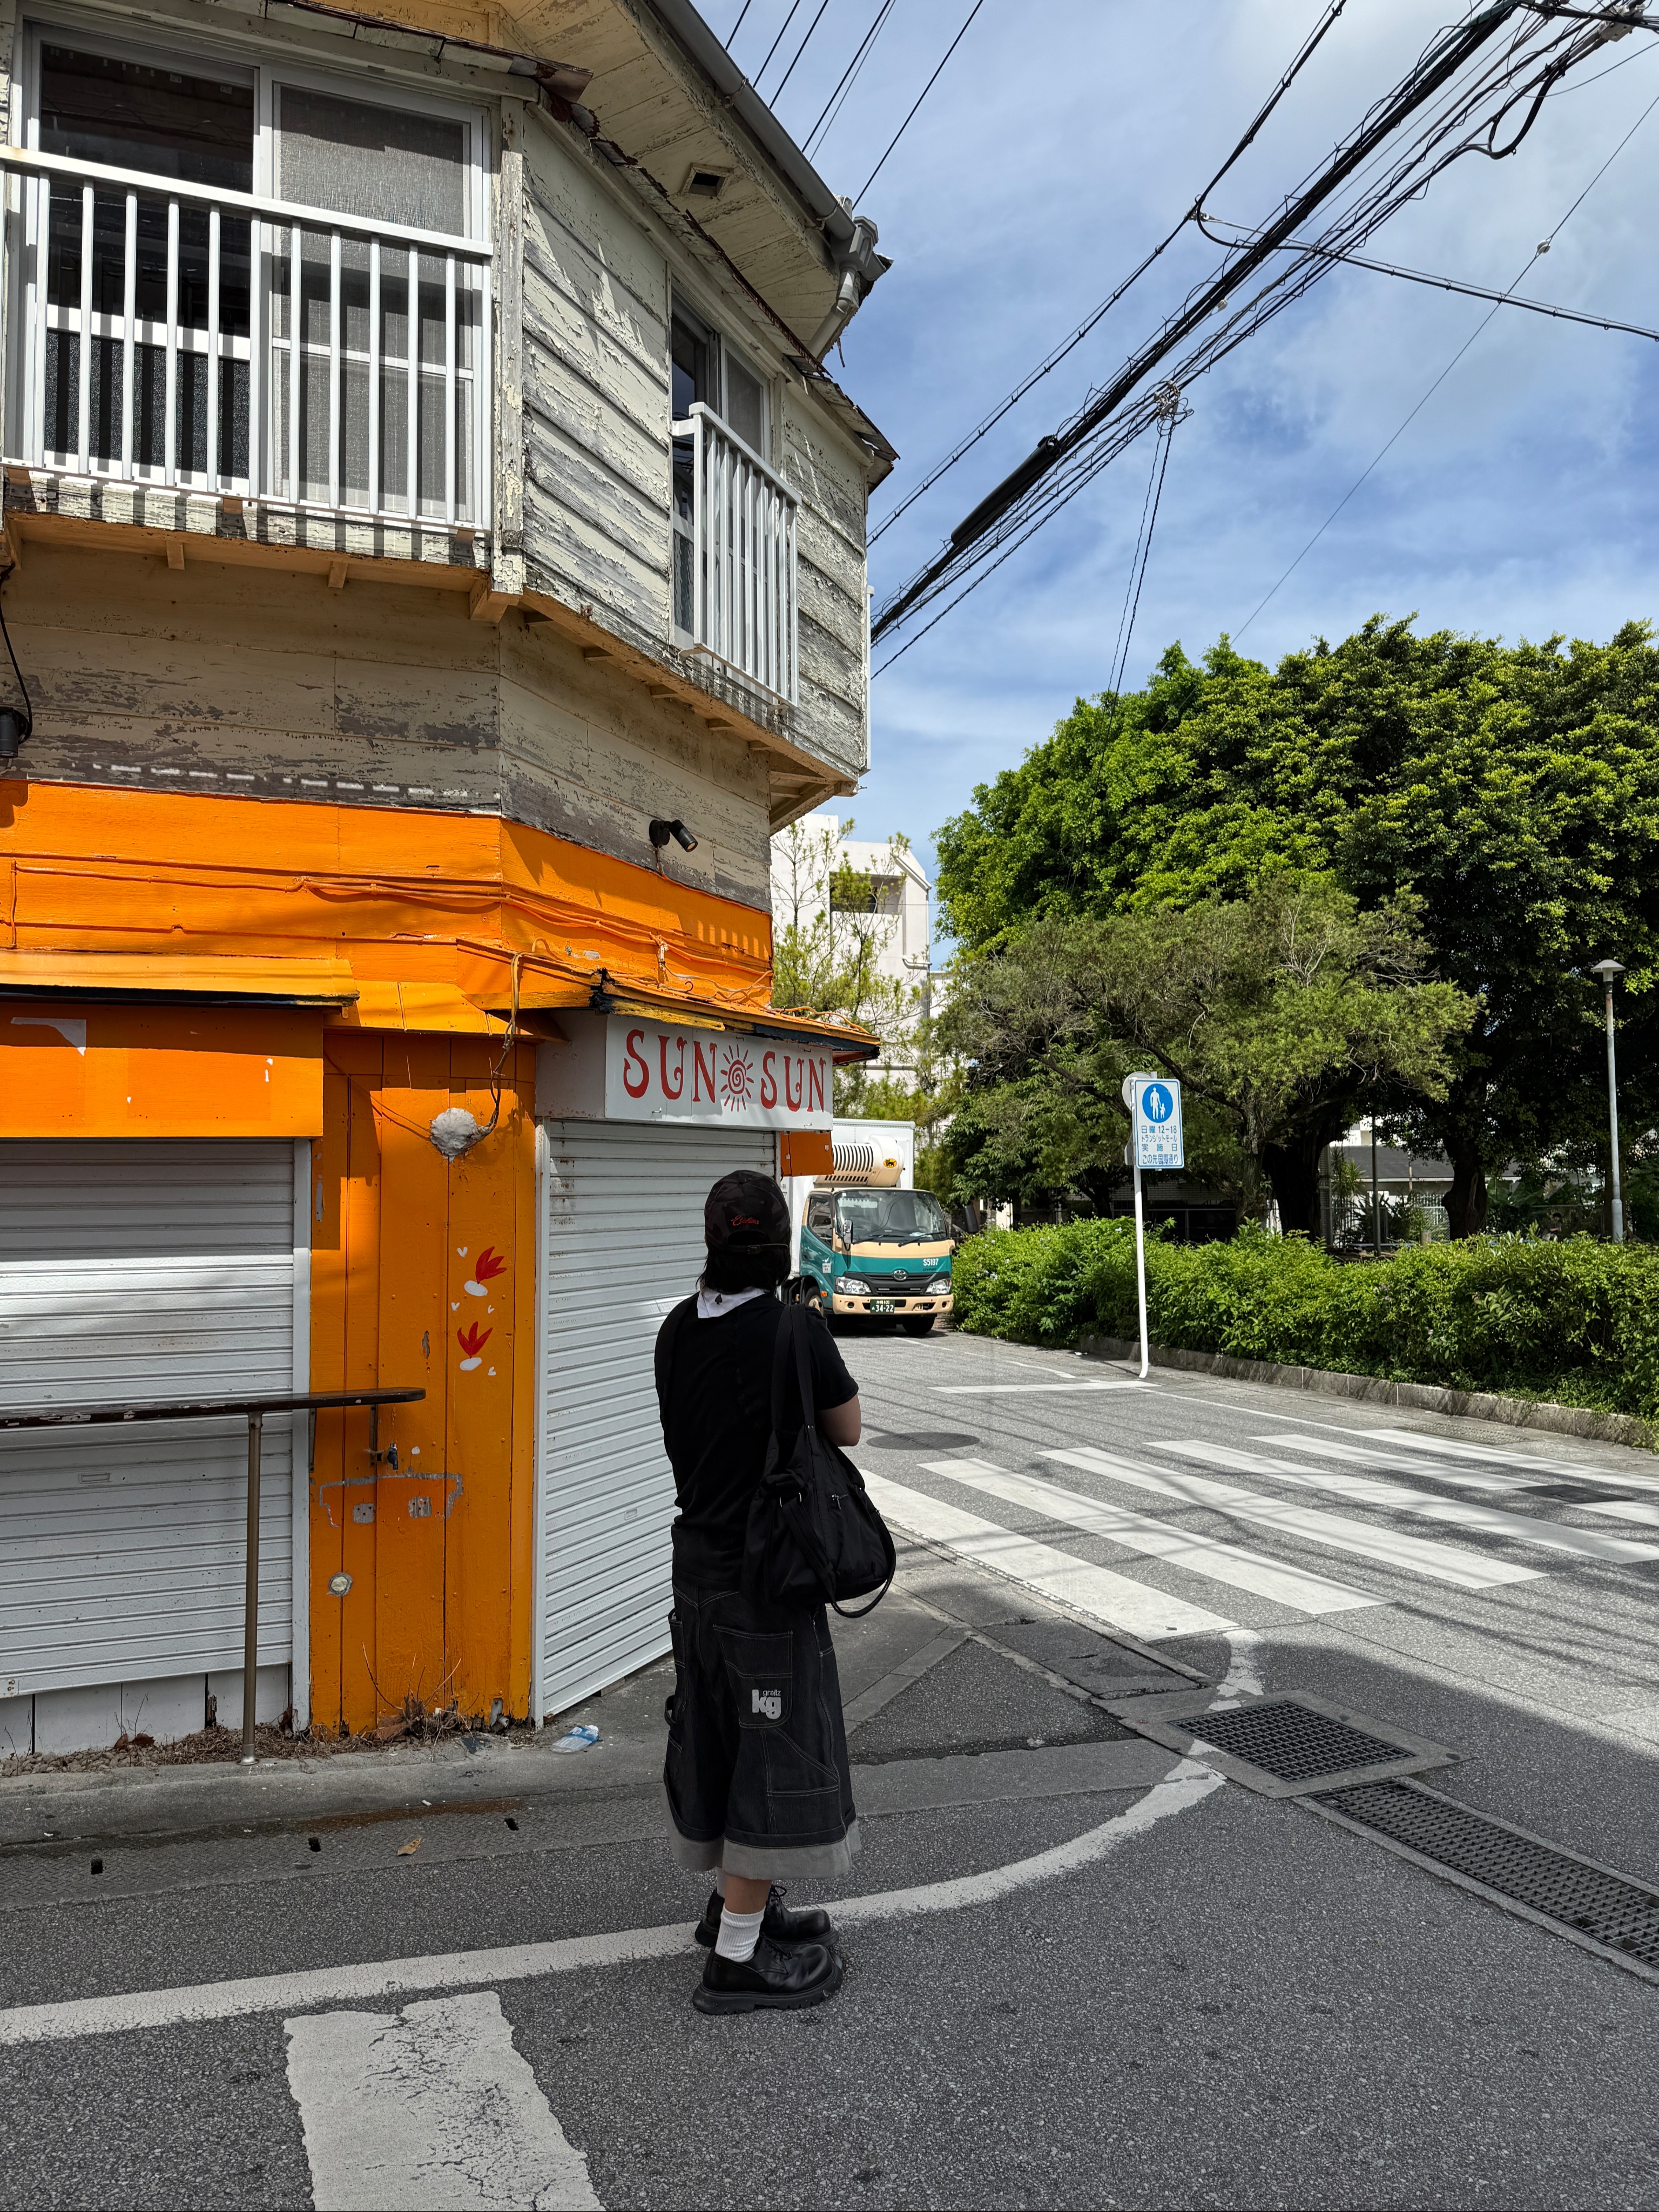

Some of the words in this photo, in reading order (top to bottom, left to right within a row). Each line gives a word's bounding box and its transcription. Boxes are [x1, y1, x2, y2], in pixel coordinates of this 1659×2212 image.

[623, 1029, 717, 1103] SUN
[761, 1051, 826, 1112] SUN
[923, 1258, 939, 1266] S5197
[752, 1689, 781, 1719] kg
